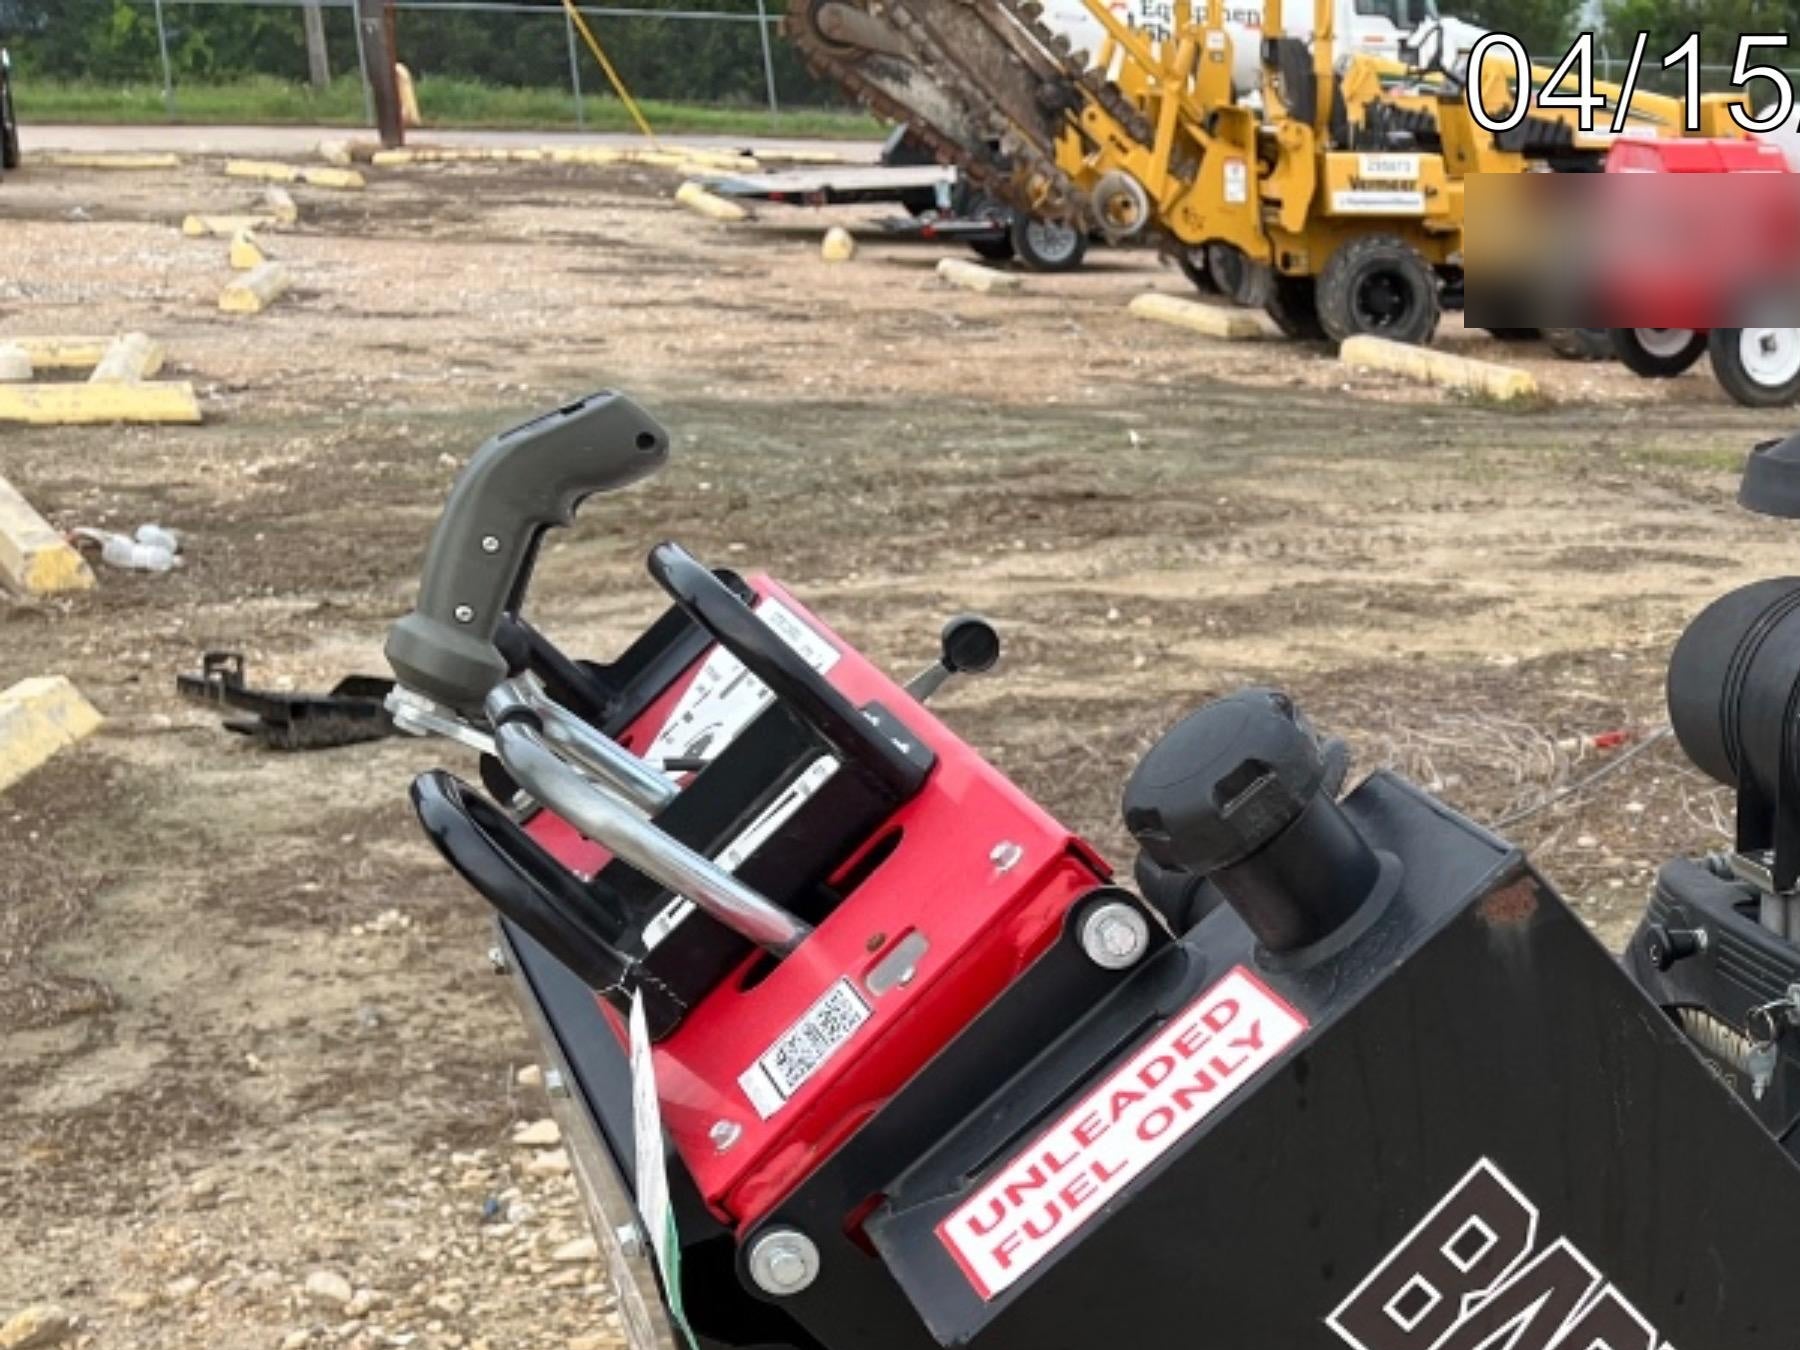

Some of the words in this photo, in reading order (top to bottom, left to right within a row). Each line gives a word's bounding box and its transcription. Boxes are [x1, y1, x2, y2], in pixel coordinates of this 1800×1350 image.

[966, 998, 1241, 1238] UNLEADED
[990, 1158, 1129, 1270] FUEL
[1136, 1019, 1264, 1141] ONLY
